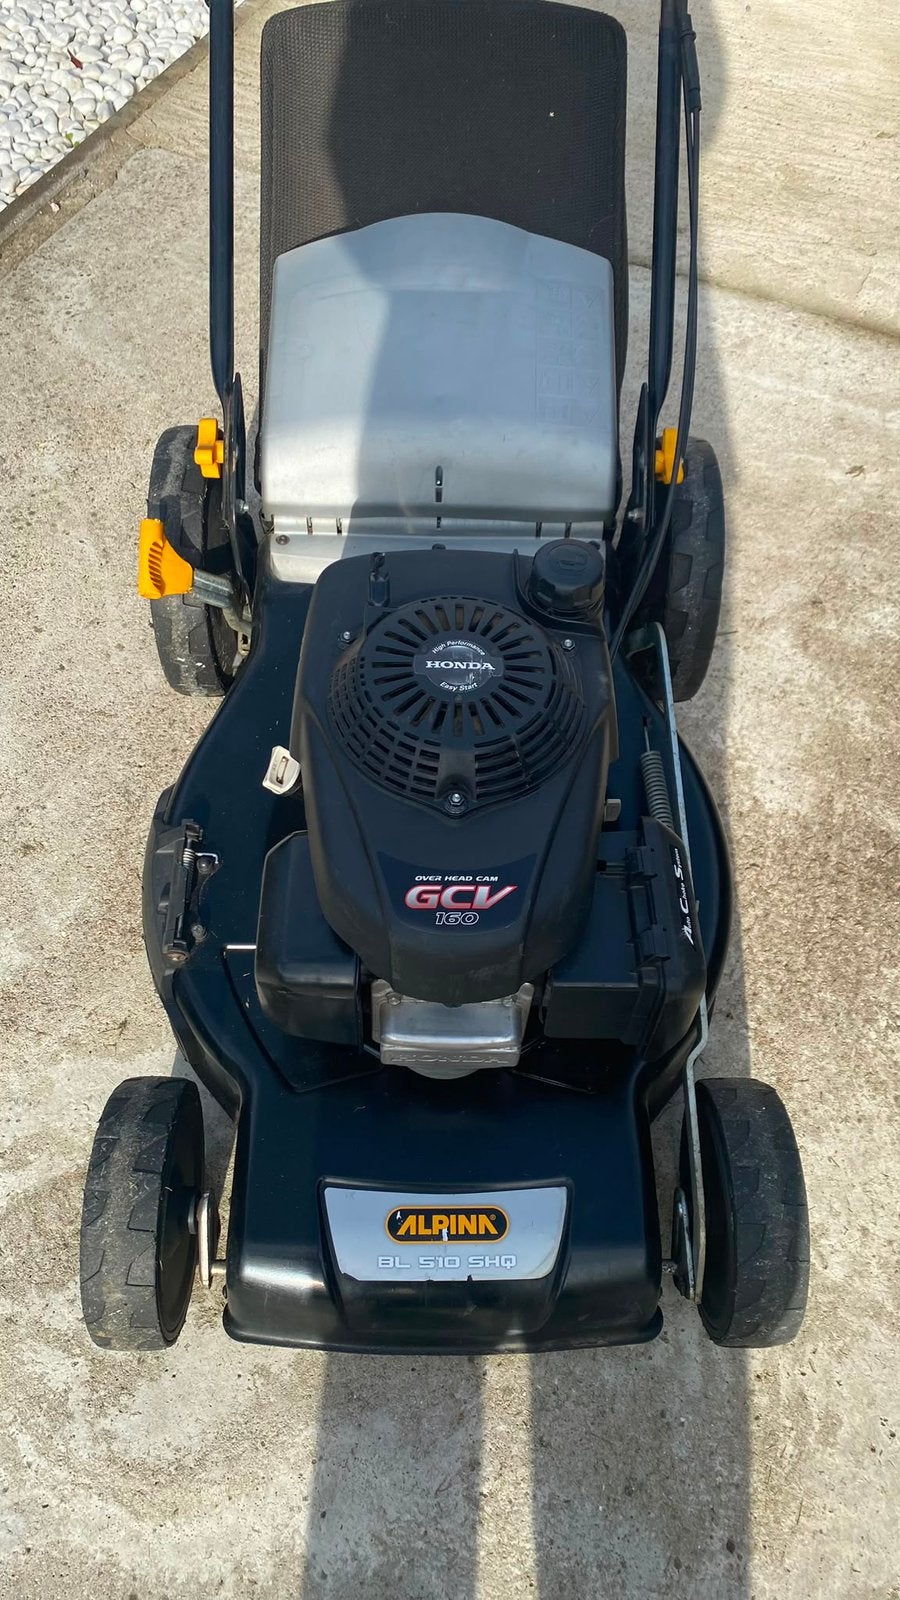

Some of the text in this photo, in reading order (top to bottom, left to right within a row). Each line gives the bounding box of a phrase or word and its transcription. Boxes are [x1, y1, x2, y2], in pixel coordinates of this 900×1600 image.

[432, 640, 486, 656] High Performance
[425, 660, 496, 670] HONDA
[440, 681, 478, 692] Easy Start
[404, 884, 518, 911] GCV
[435, 911, 480, 926] 160
[390, 1053, 510, 1065] HONDA
[396, 1214, 499, 1236] ALPINA
[377, 1254, 518, 1270] BL 510 SHQ
